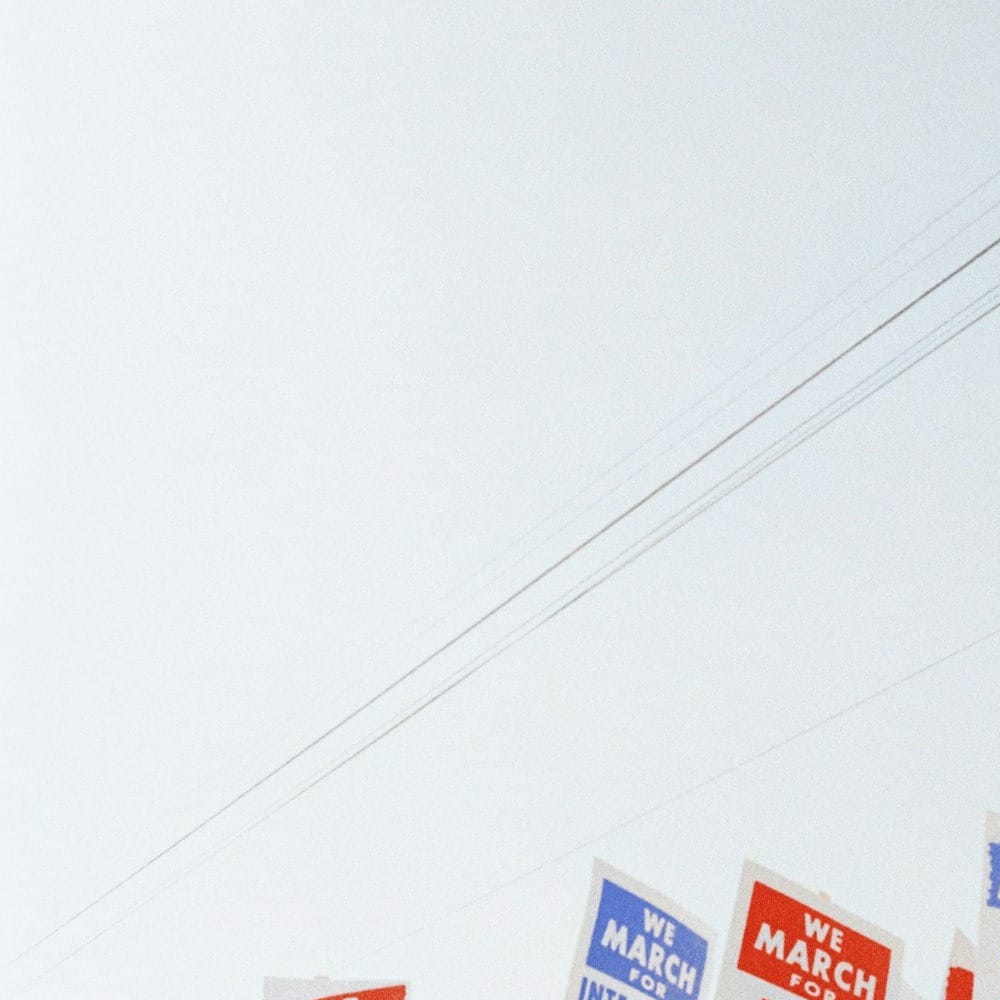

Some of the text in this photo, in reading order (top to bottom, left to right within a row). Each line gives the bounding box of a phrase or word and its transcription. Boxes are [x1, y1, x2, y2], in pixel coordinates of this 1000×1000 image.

[643, 907, 676, 947] WE
[804, 912, 844, 953] WE
[601, 918, 697, 996] MARCH
[628, 966, 667, 1000] FOR
